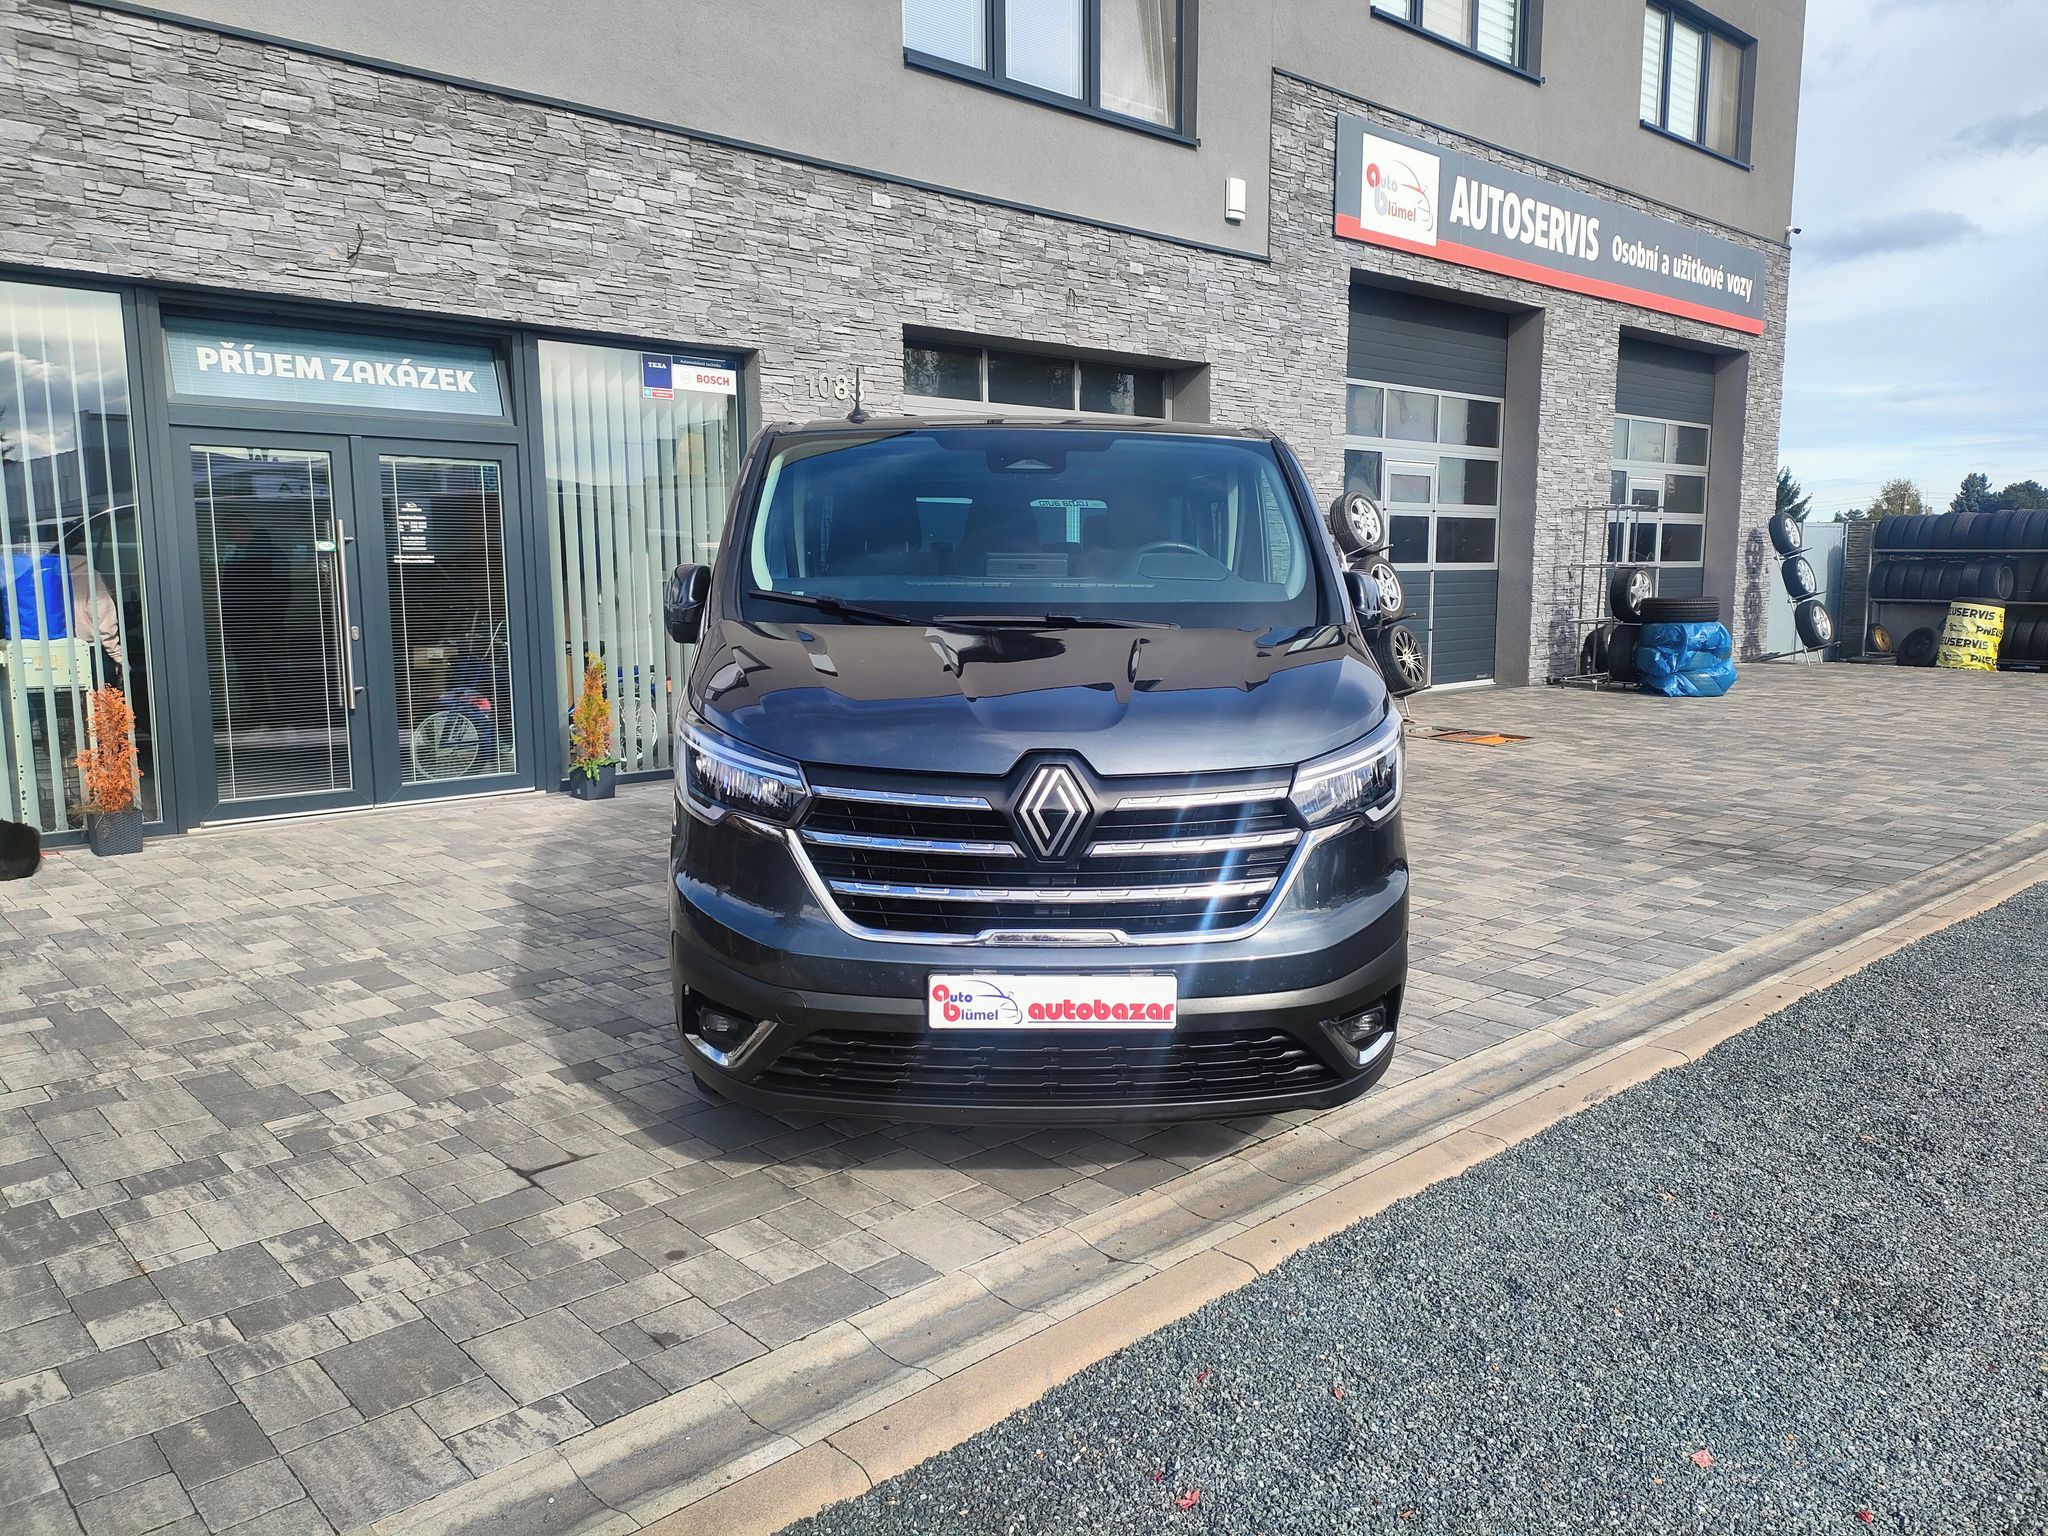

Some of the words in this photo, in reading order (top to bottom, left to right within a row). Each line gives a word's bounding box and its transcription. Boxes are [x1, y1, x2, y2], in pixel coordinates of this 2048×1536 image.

[1366, 163, 1398, 192] auto
[1375, 187, 1416, 222] blümel
[1449, 175, 1600, 262] AUTOSERVIS
[1612, 235, 1660, 272] Osobní
[1661, 254, 1670, 276] a
[1673, 253, 1724, 290] užitkové
[1727, 272, 1753, 303] vozy
[196, 341, 326, 381] PŘÍJEM
[330, 358, 478, 393] ZAKÁZEK
[647, 361, 667, 369] TEXA
[696, 374, 730, 387] BOSCH
[932, 984, 973, 1003] auto
[943, 1001, 998, 1022] blümel
[1027, 999, 1175, 1021] autobazar
